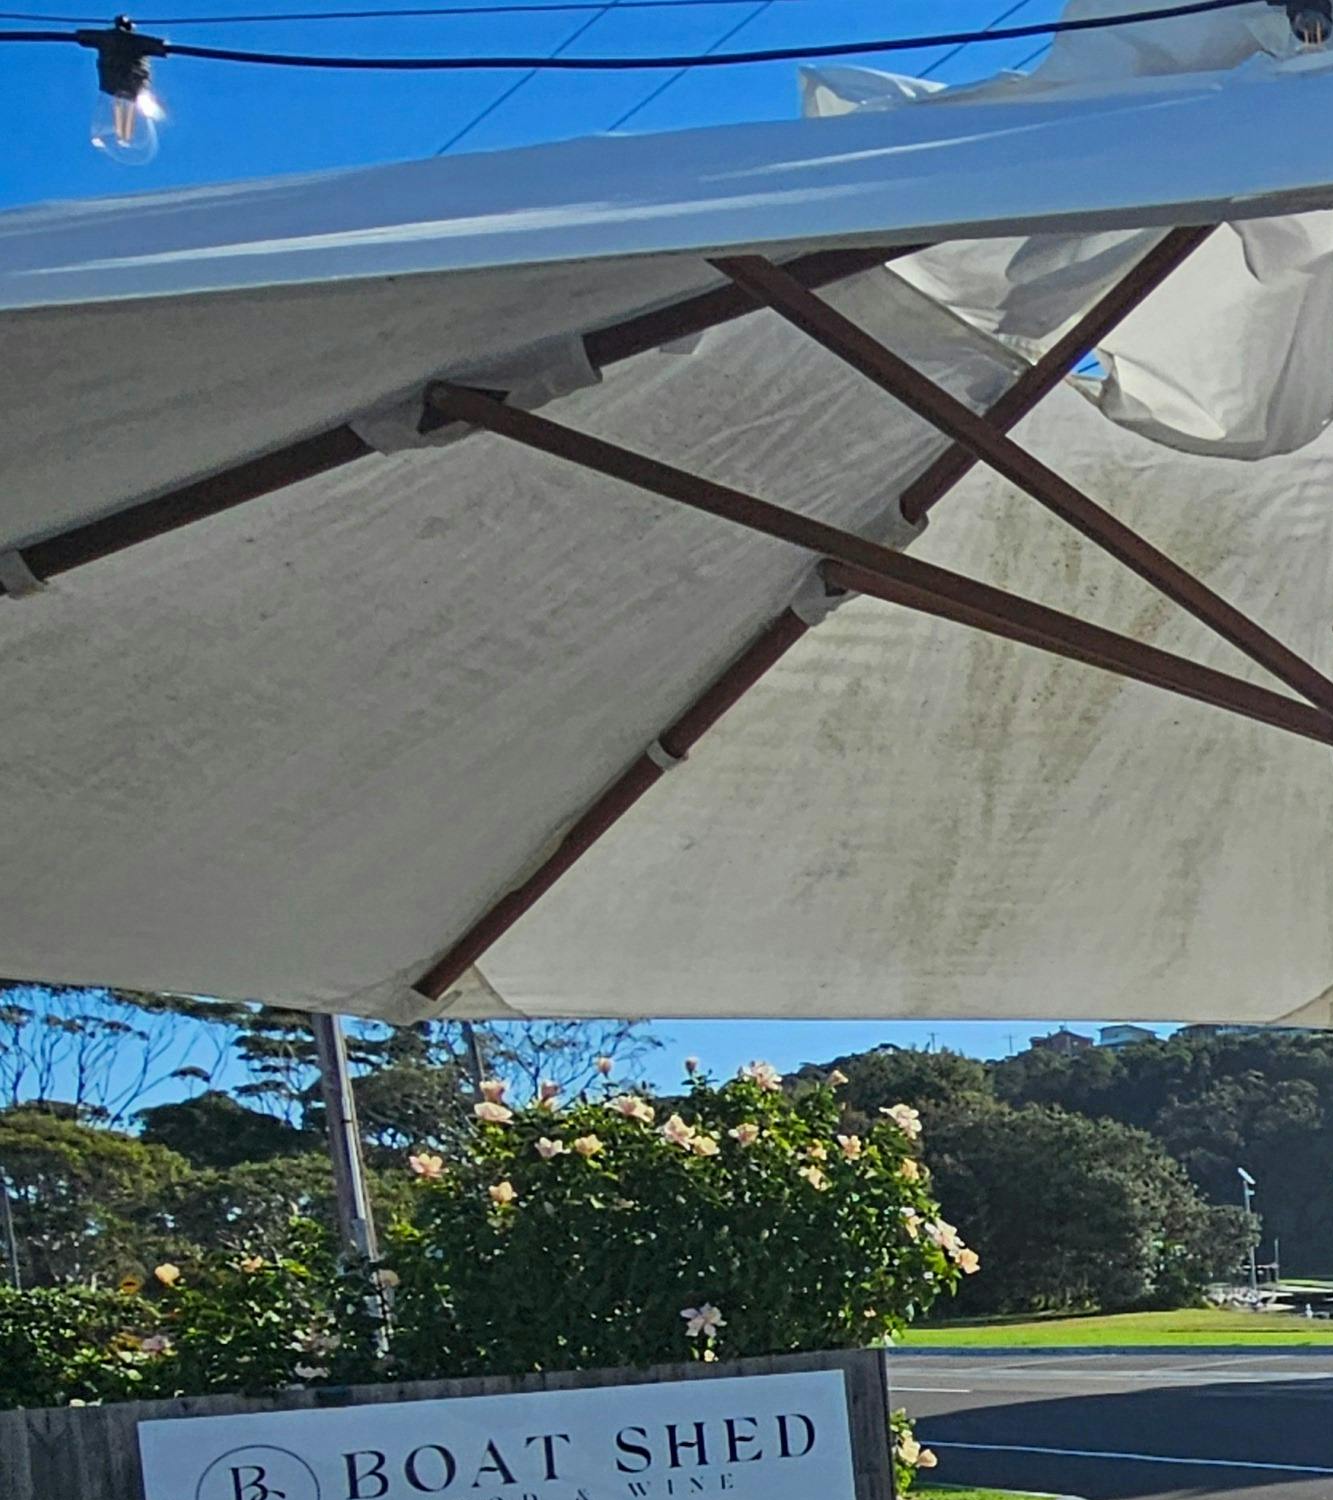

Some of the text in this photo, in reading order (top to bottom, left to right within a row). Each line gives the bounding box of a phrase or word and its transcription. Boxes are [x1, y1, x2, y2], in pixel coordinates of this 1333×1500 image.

[342, 1413, 816, 1500] BOAT SHED
[628, 1473, 734, 1498] WINE
